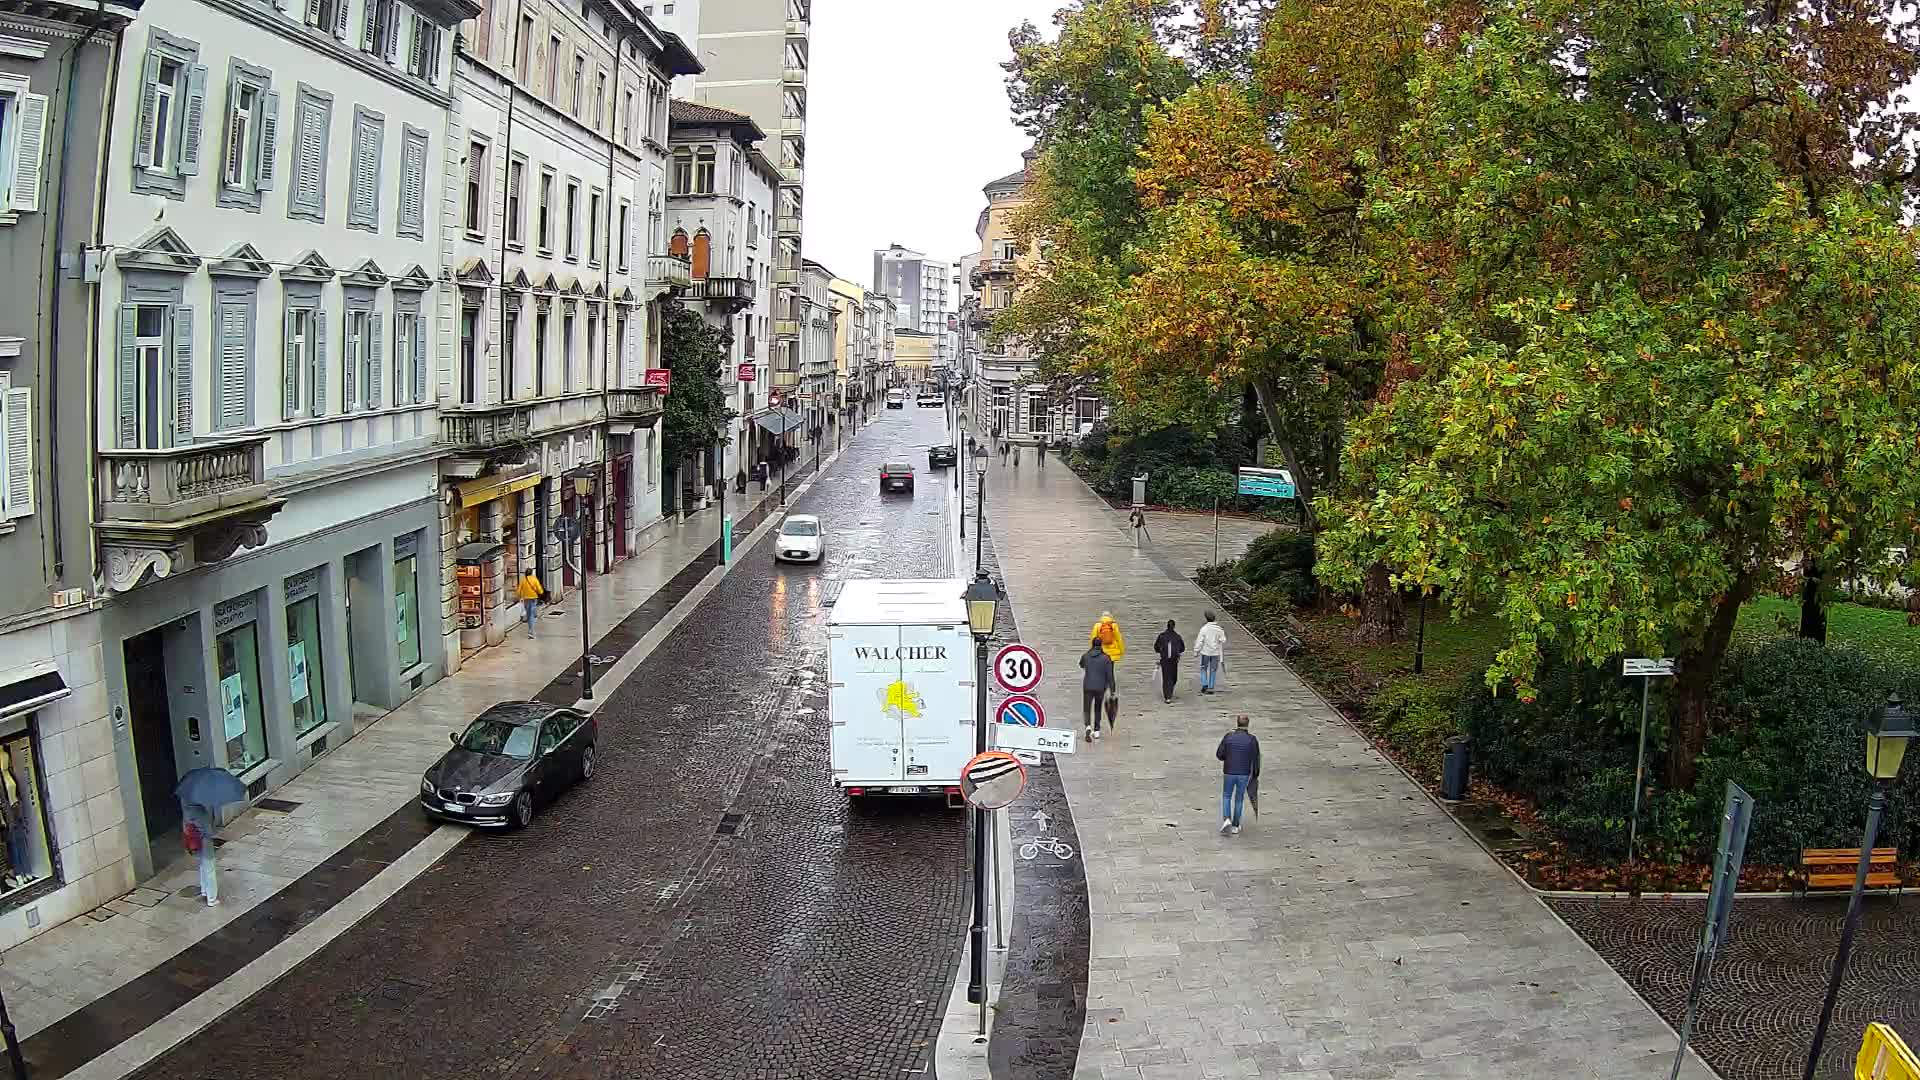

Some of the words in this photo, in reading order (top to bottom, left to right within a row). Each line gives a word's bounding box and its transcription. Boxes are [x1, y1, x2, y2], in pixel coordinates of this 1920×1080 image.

[855, 646, 947, 660] WALCHER
[1005, 658, 1033, 680] 30
[1038, 737, 1069, 748] Dante
